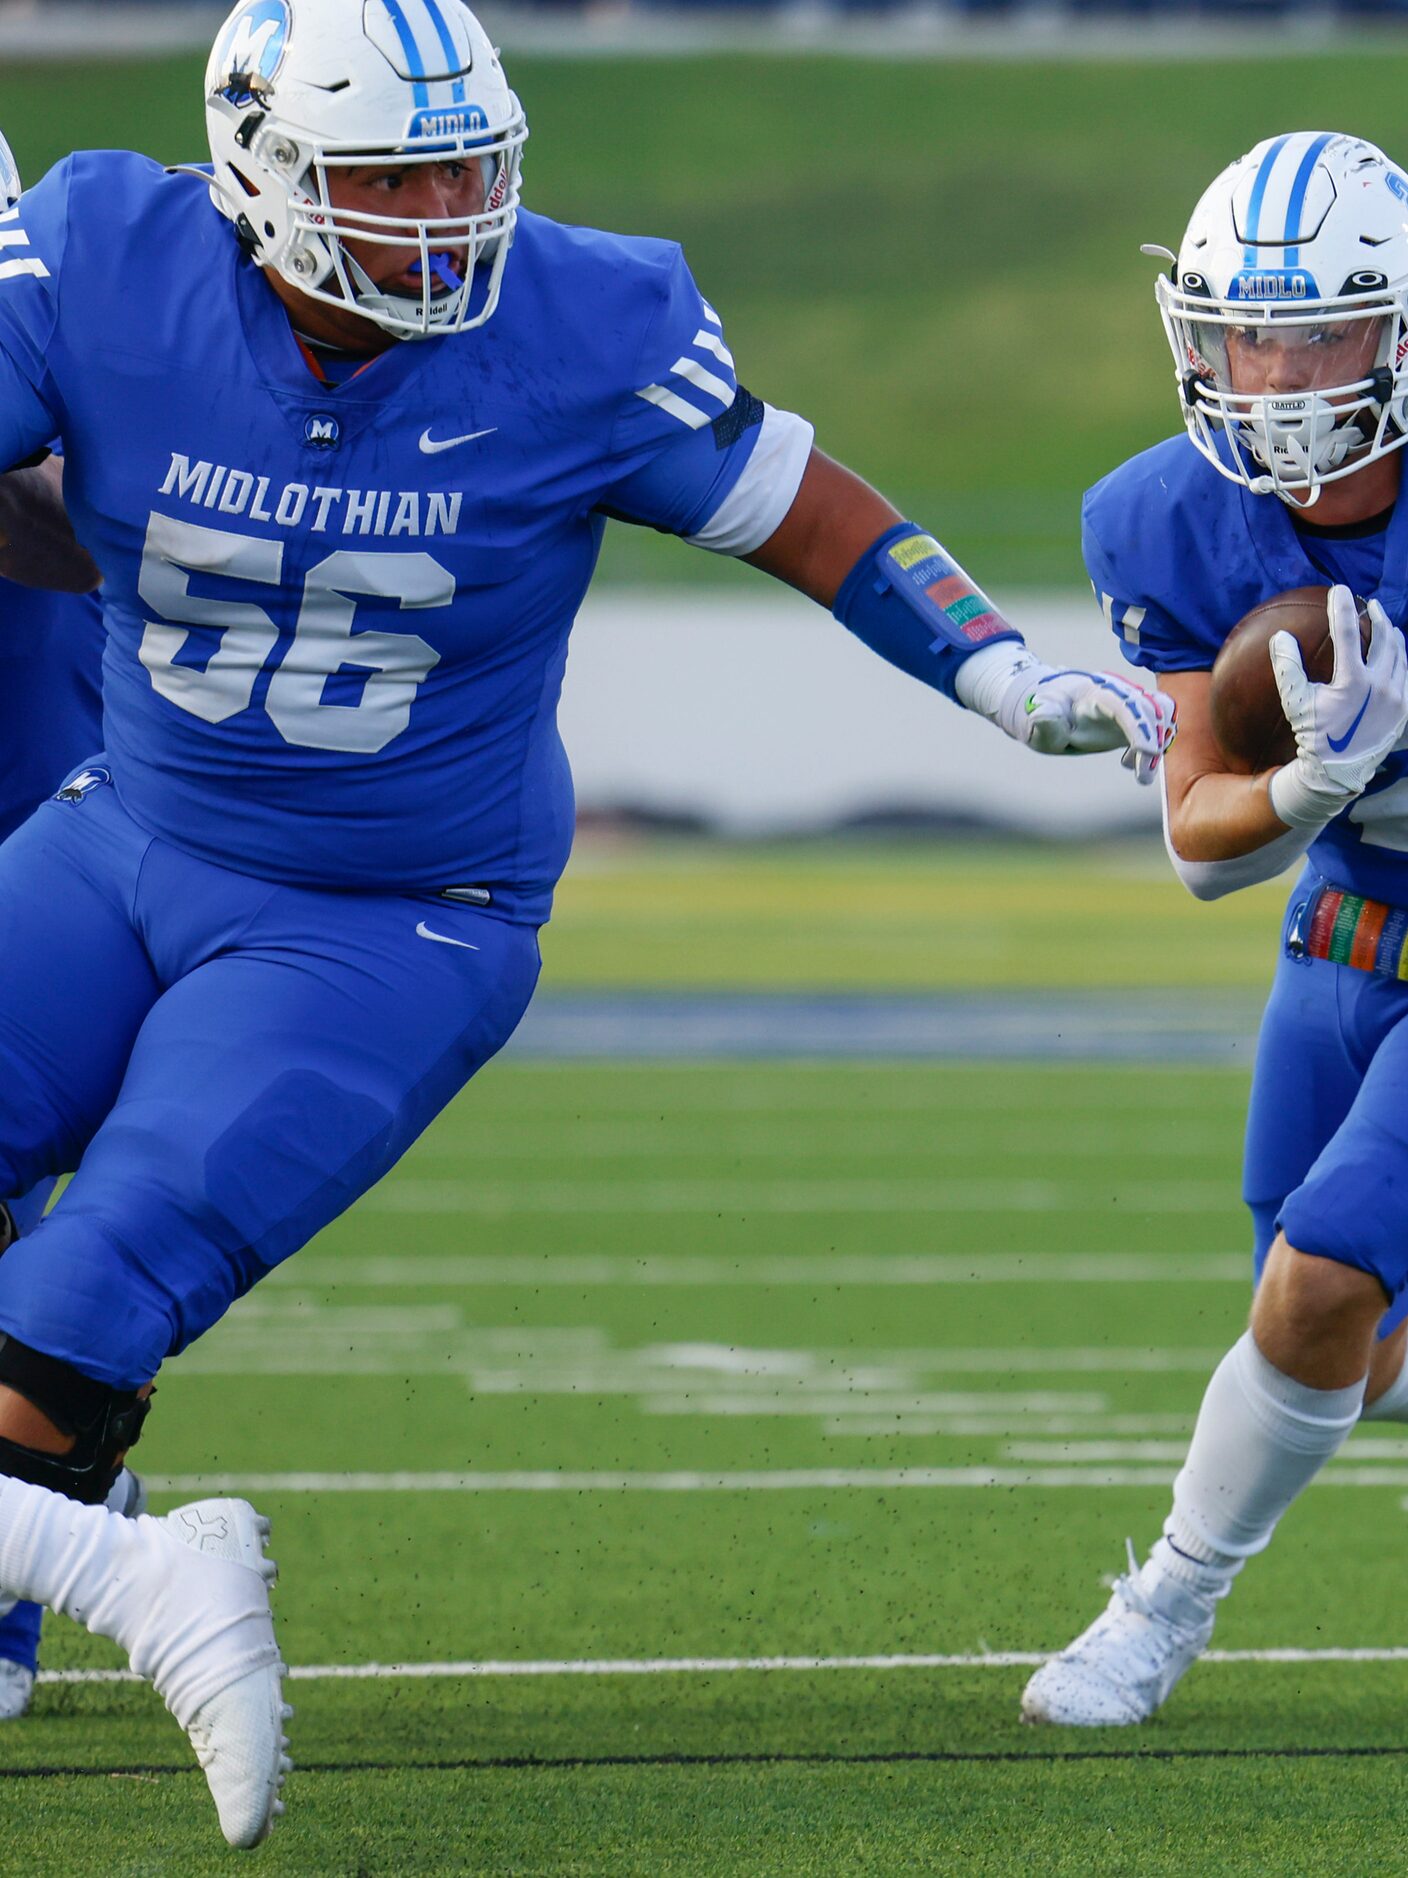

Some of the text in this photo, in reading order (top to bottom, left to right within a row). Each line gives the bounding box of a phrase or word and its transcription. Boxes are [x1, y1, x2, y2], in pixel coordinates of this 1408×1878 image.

[421, 112, 481, 137] MIDLO
[1238, 275, 1306, 299] MIDLO
[1273, 401, 1303, 409] BATTLE
[311, 420, 333, 439] M
[157, 453, 463, 536] MIDLOTHIAN
[138, 510, 456, 753] 56
